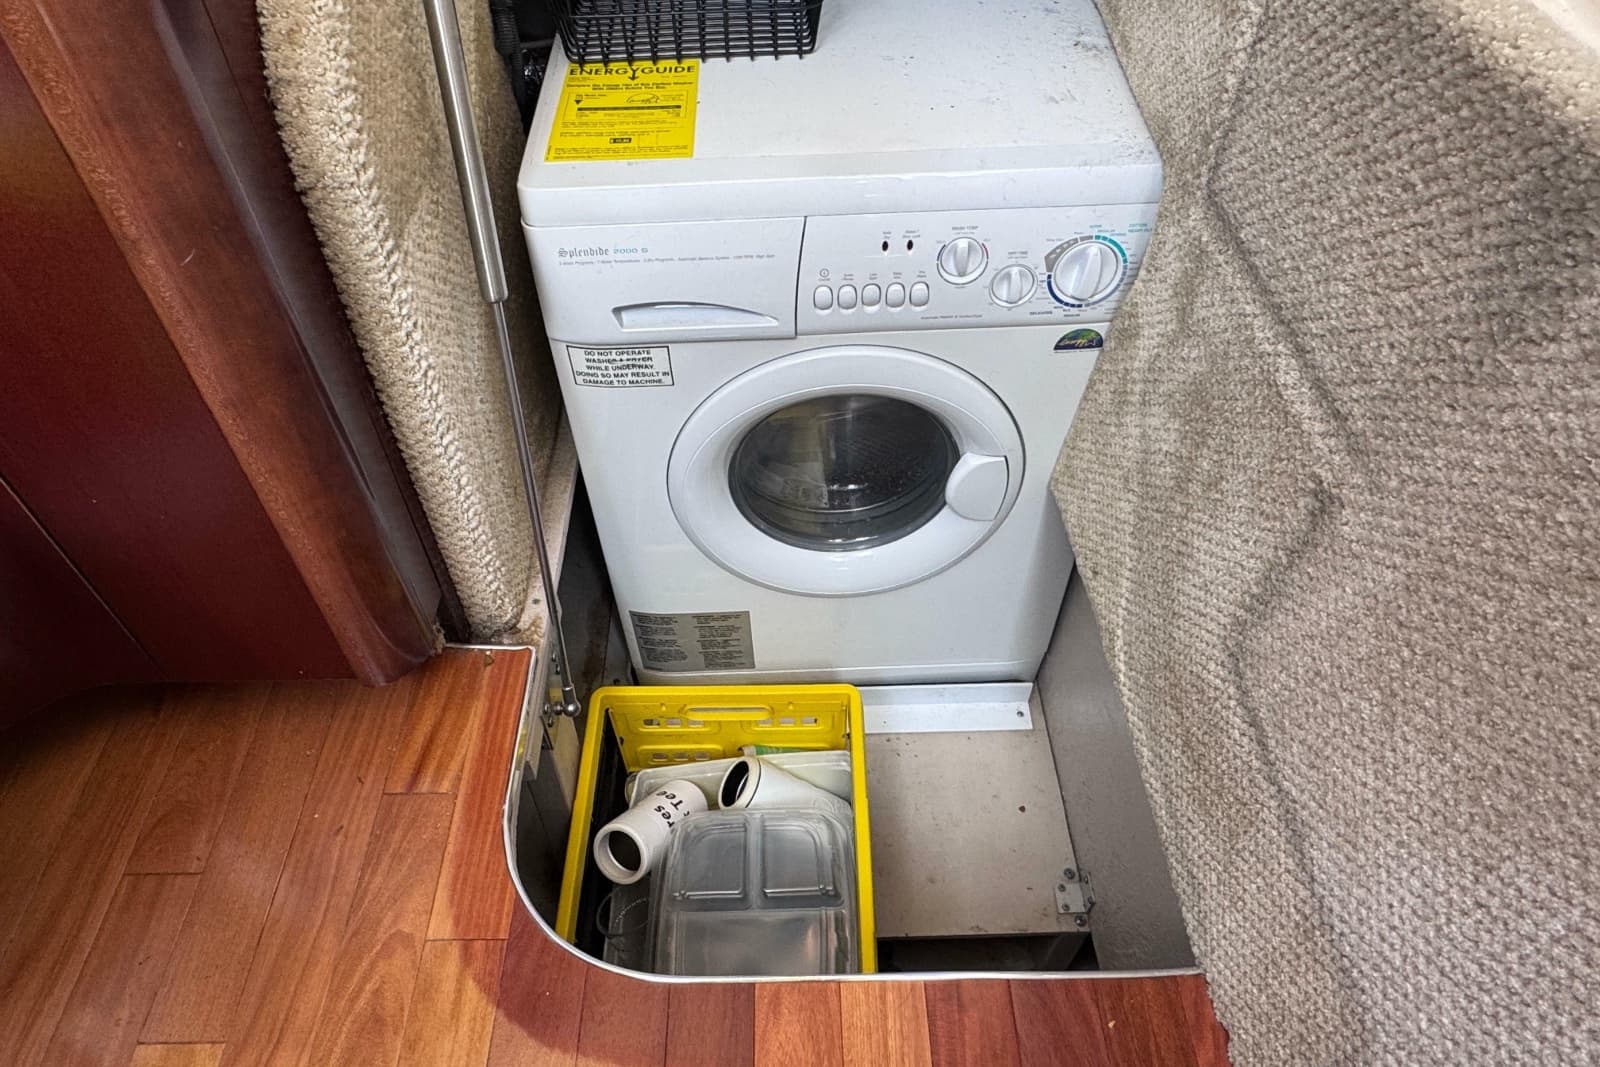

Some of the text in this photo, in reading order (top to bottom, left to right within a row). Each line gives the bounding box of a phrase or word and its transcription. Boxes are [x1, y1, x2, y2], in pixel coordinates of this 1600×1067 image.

[558, 246, 609, 258] Splendide
[575, 370, 599, 378] DOING
[600, 371, 612, 379] SO
[631, 370, 660, 378] RESULT
[582, 378, 615, 386] DAMAGE
[653, 805, 676, 829] res
